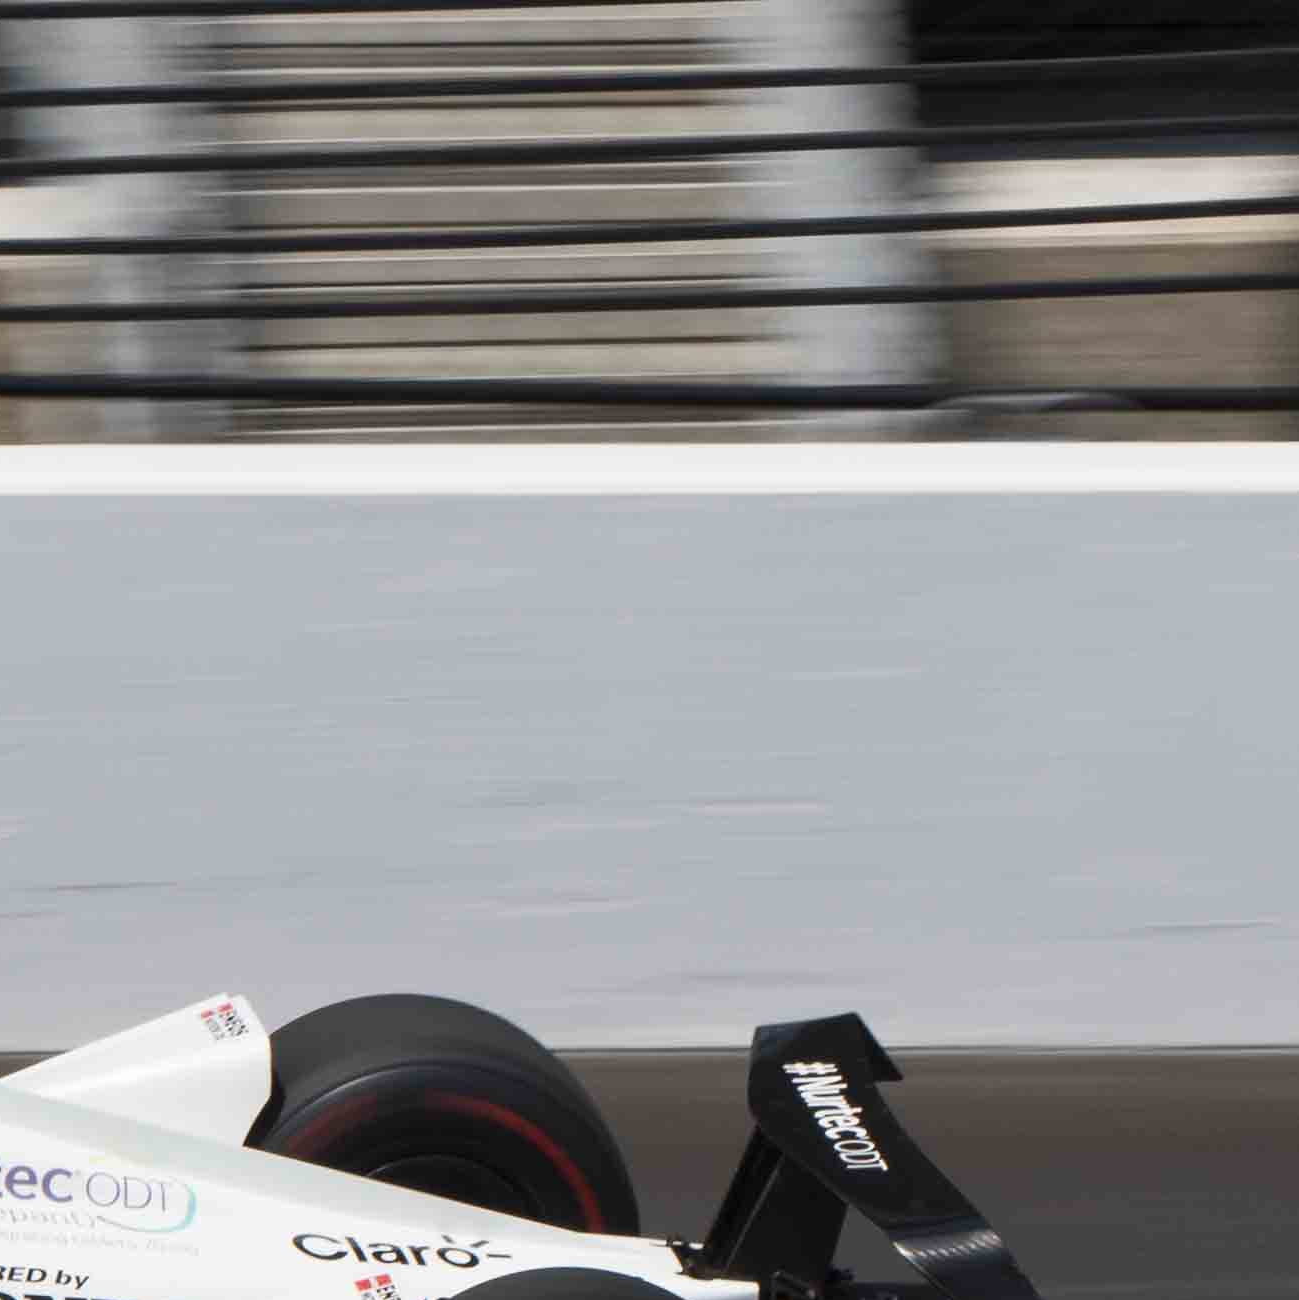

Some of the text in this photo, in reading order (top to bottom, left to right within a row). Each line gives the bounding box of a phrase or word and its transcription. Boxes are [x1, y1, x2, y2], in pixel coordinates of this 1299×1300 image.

[85, 1171, 173, 1212] ODT
[292, 1233, 480, 1268] Claro
[54, 1269, 90, 1290] by
